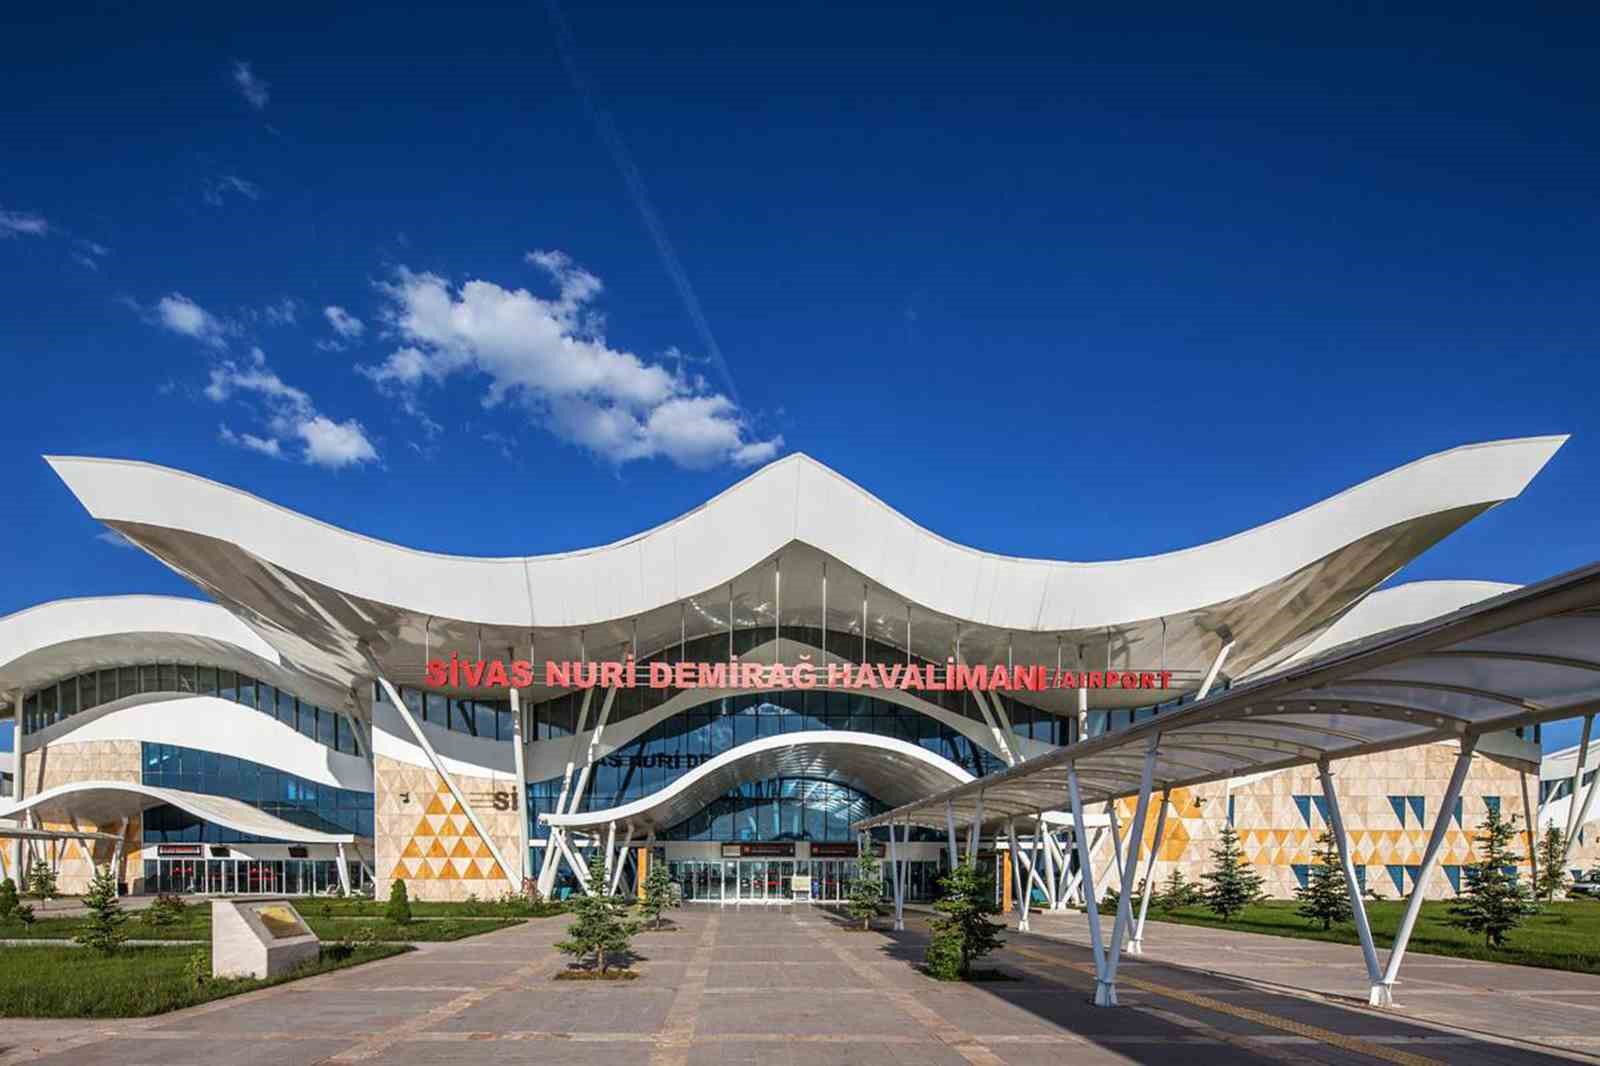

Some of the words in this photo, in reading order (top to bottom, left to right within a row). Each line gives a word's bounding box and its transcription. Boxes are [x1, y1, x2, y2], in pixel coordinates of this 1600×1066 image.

[424, 650, 535, 688] SİVAS
[546, 652, 636, 688] NURİ
[650, 654, 817, 689] DEMİRAĞ
[827, 656, 1048, 691] HAVALİMANI
